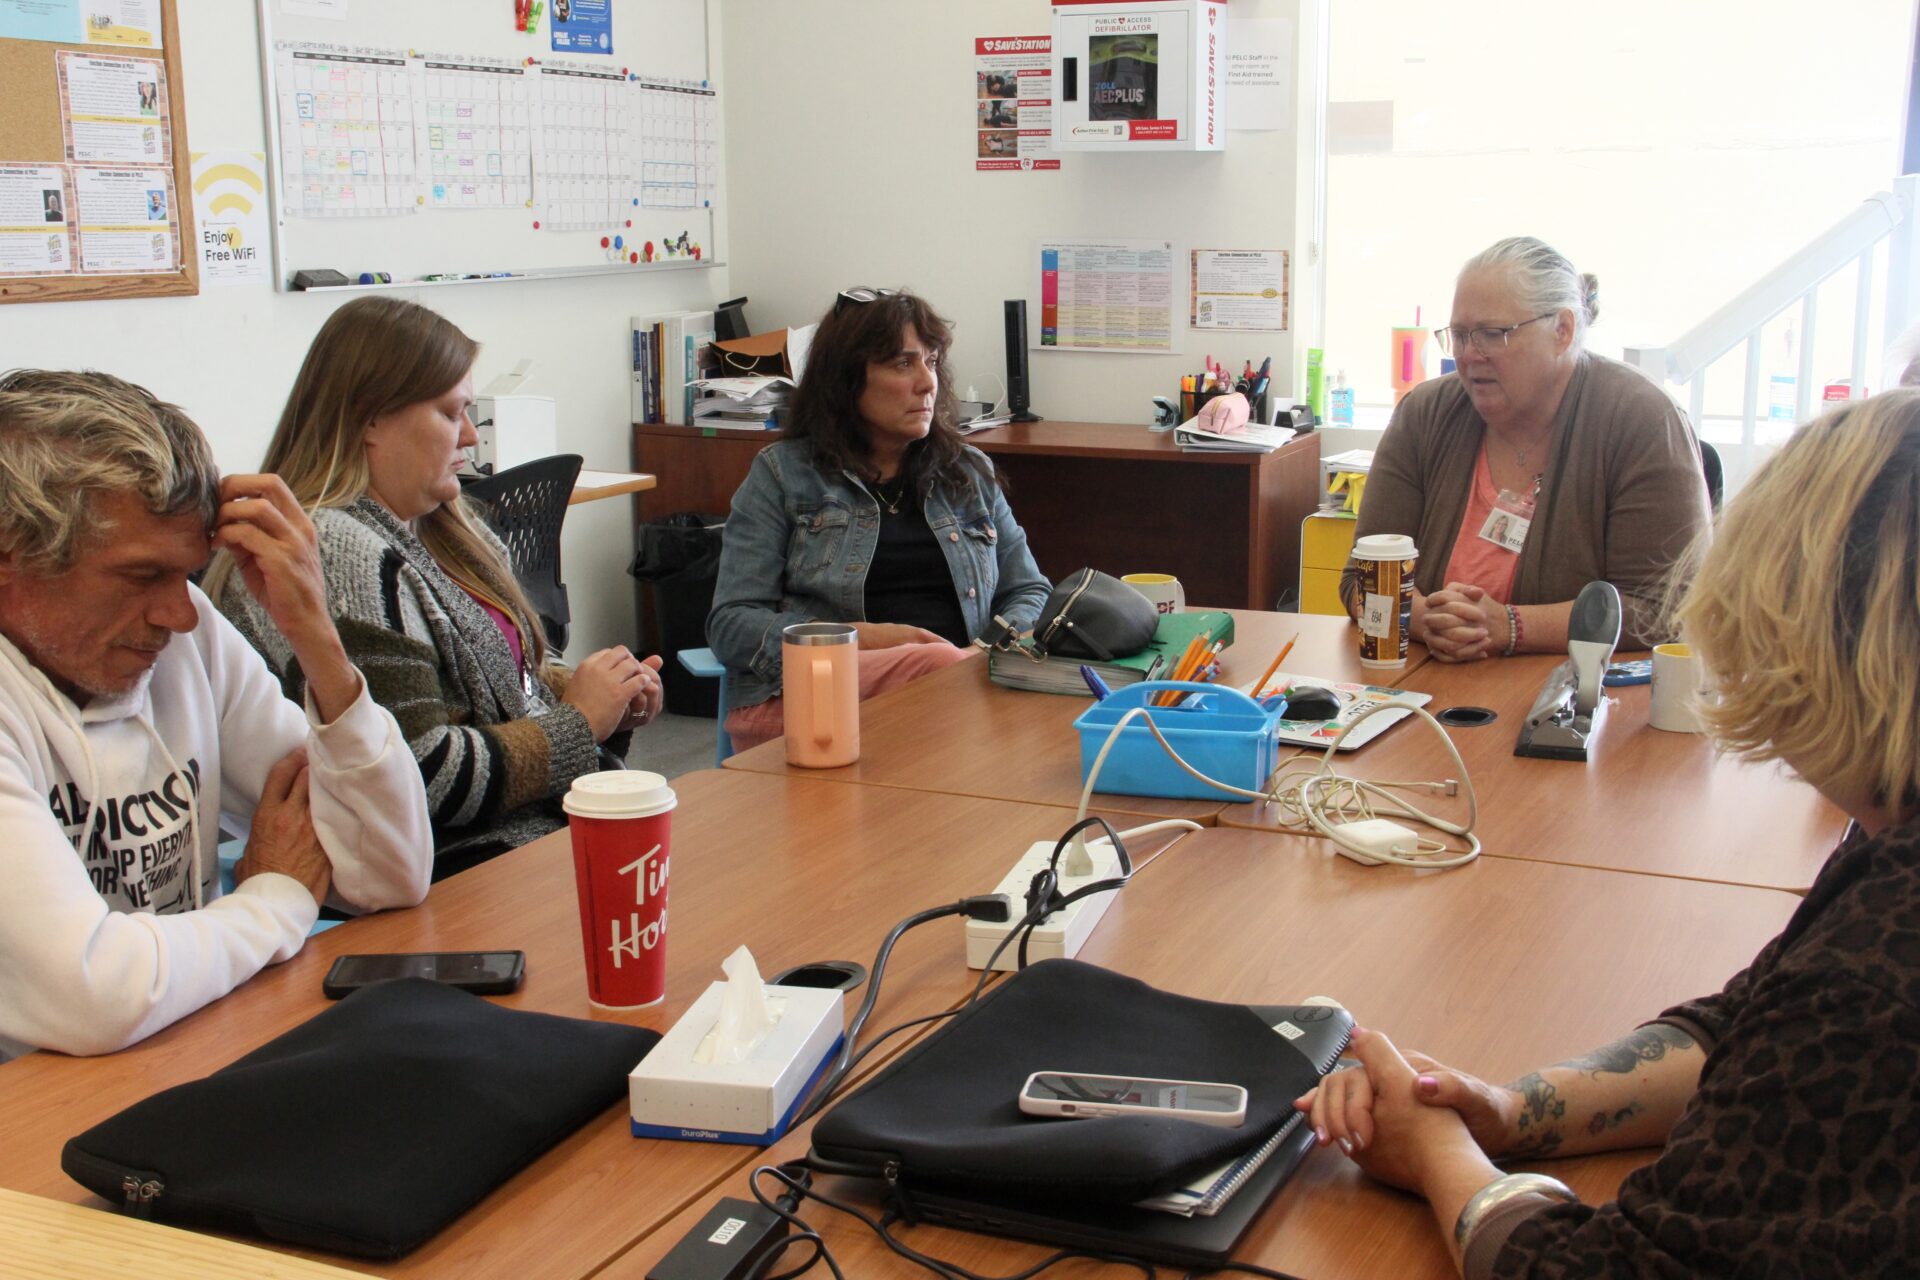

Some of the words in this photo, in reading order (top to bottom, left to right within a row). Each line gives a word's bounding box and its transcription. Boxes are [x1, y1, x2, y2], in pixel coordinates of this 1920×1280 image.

[1095, 24, 1152, 33] DEFIBRILLATOR
[204, 230, 234, 246] Enjoy
[205, 249, 230, 262] Free
[231, 247, 256, 260] WiFi
[681, 1129, 719, 1139] DuroPlus
